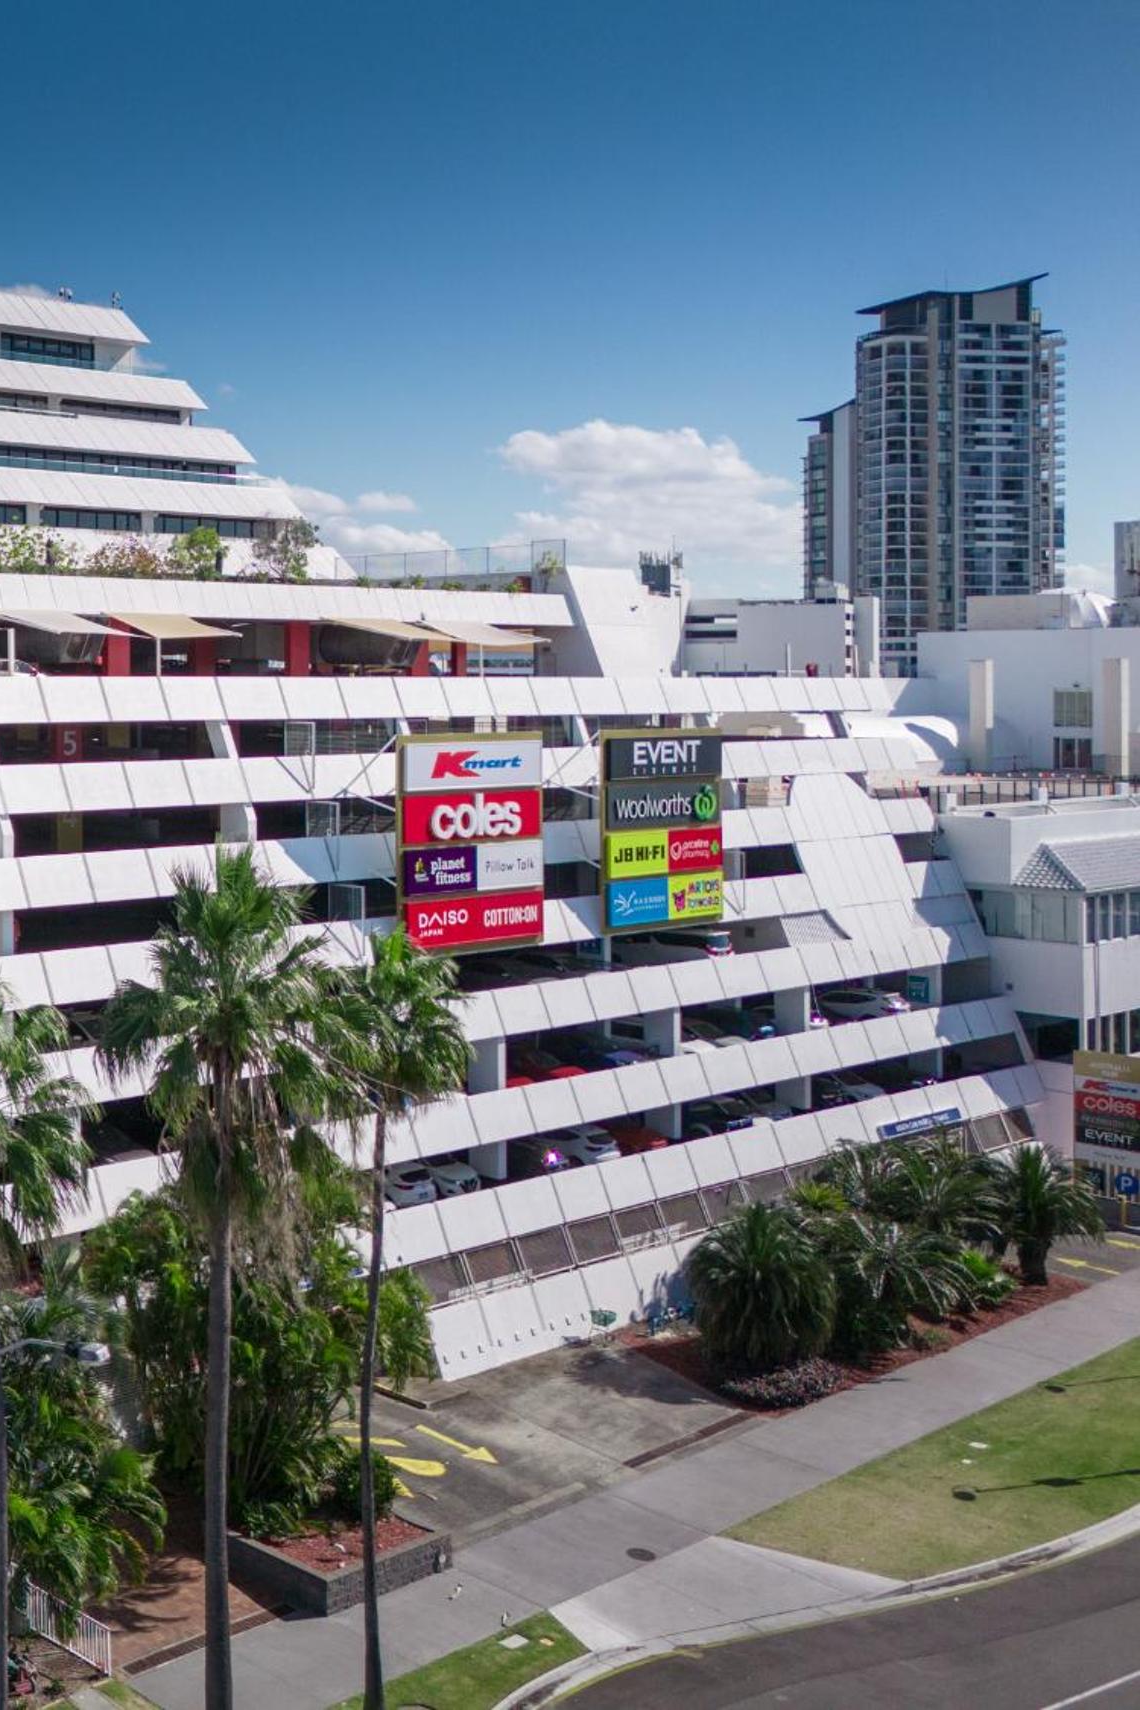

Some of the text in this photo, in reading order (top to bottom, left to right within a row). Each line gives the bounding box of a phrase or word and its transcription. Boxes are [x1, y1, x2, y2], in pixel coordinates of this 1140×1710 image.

[63, 731, 77, 756] 5
[633, 740, 702, 765] EVENT
[431, 751, 522, 779] Kmart
[431, 793, 522, 840] coles
[517, 857, 534, 871] Talk
[614, 848, 633, 863] JB
[431, 856, 465, 875] planet
[436, 871, 472, 885] fitness
[418, 908, 468, 928] DAISO
[419, 928, 443, 938] JAPAN
[1083, 1096, 1136, 1116] coles
[1085, 1127, 1135, 1145] EVENT
[1121, 1175, 1133, 1191] P
